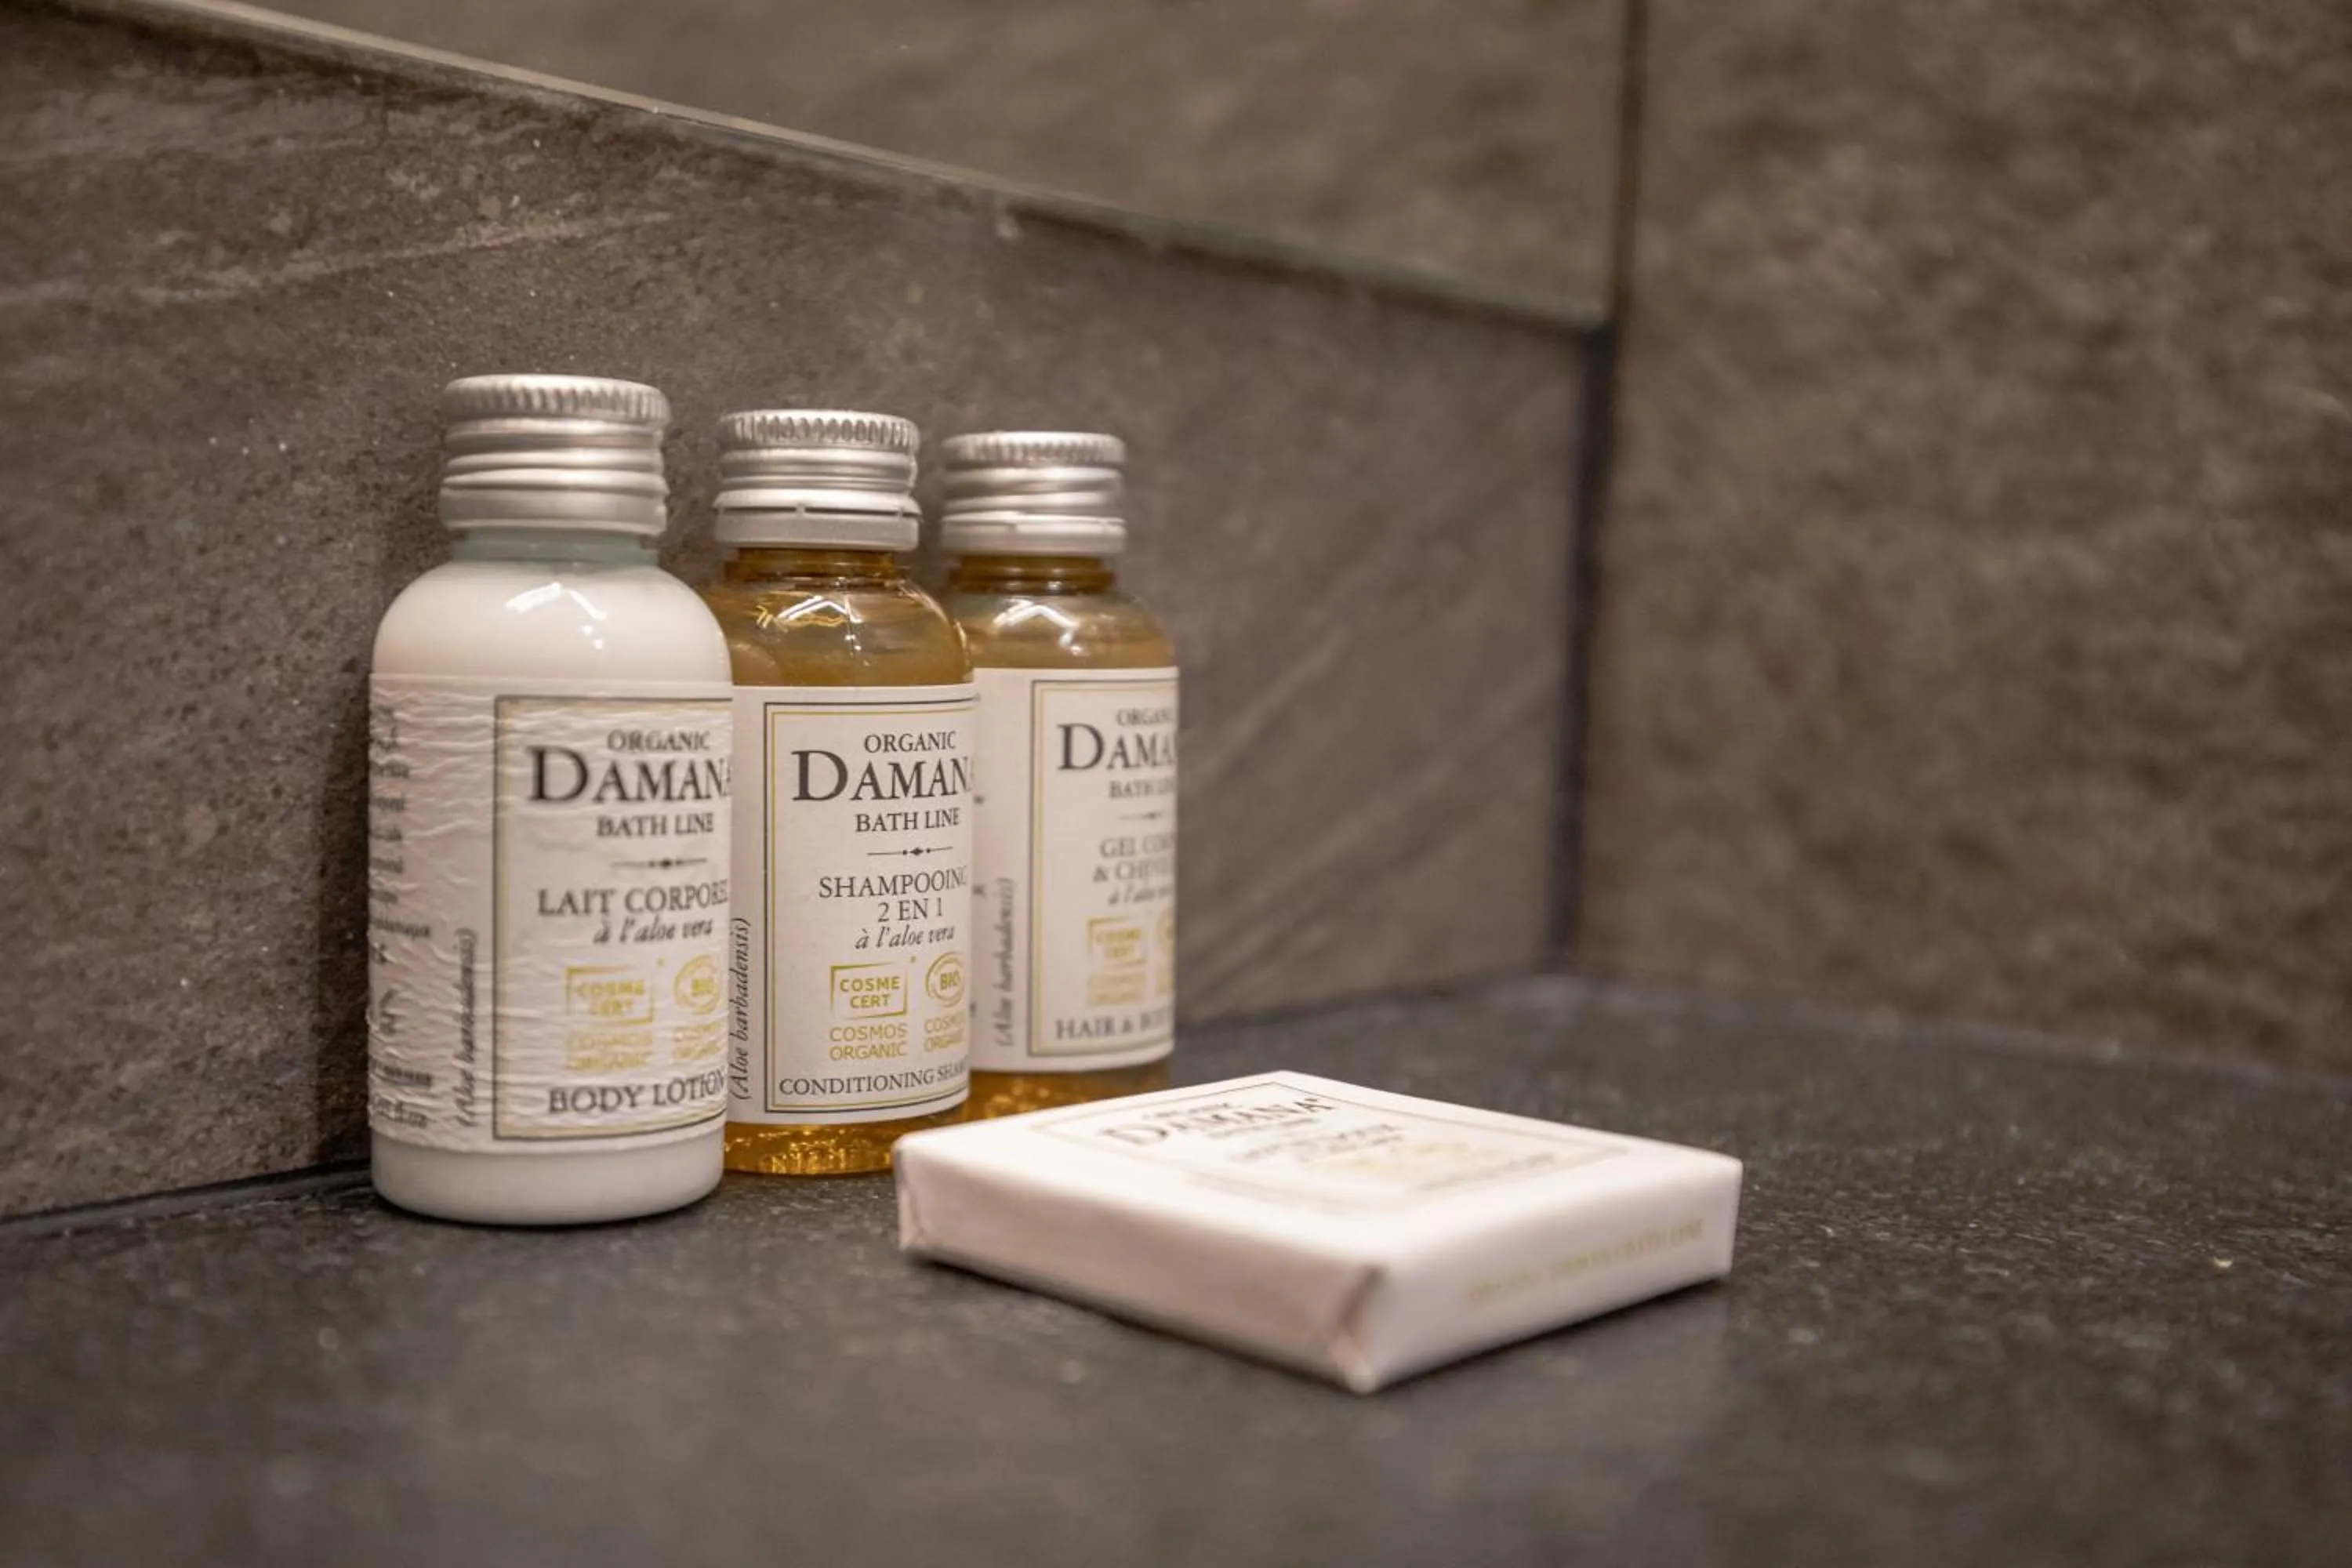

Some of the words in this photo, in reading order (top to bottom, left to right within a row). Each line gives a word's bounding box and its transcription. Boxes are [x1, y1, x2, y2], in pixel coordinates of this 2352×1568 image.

[607, 729, 710, 753] ORGANIC
[864, 730, 956, 753] ORGANIC
[1056, 723, 1177, 770] DAMA
[790, 749, 972, 801] DAMAN
[597, 815, 667, 838] BATH
[675, 811, 714, 835] LINE
[855, 811, 919, 833] BATH
[925, 808, 960, 829] LINE
[537, 887, 618, 916] LAIT
[877, 902, 891, 923] 2
[898, 898, 929, 922] EN
[855, 928, 869, 949] à
[876, 924, 924, 949] l'aloe
[928, 925, 956, 944] vera
[729, 917, 752, 1042] barbadensis)
[839, 975, 902, 993] COSME
[851, 993, 891, 1009] CERT
[829, 1021, 909, 1042] COSMOS
[1055, 1016, 1115, 1040] HAIR
[829, 1040, 909, 1062] ORGANIC
[729, 1047, 752, 1100] (Aloe
[779, 1067, 935, 1096] CONDITIONING
[550, 1085, 644, 1114] BODY
